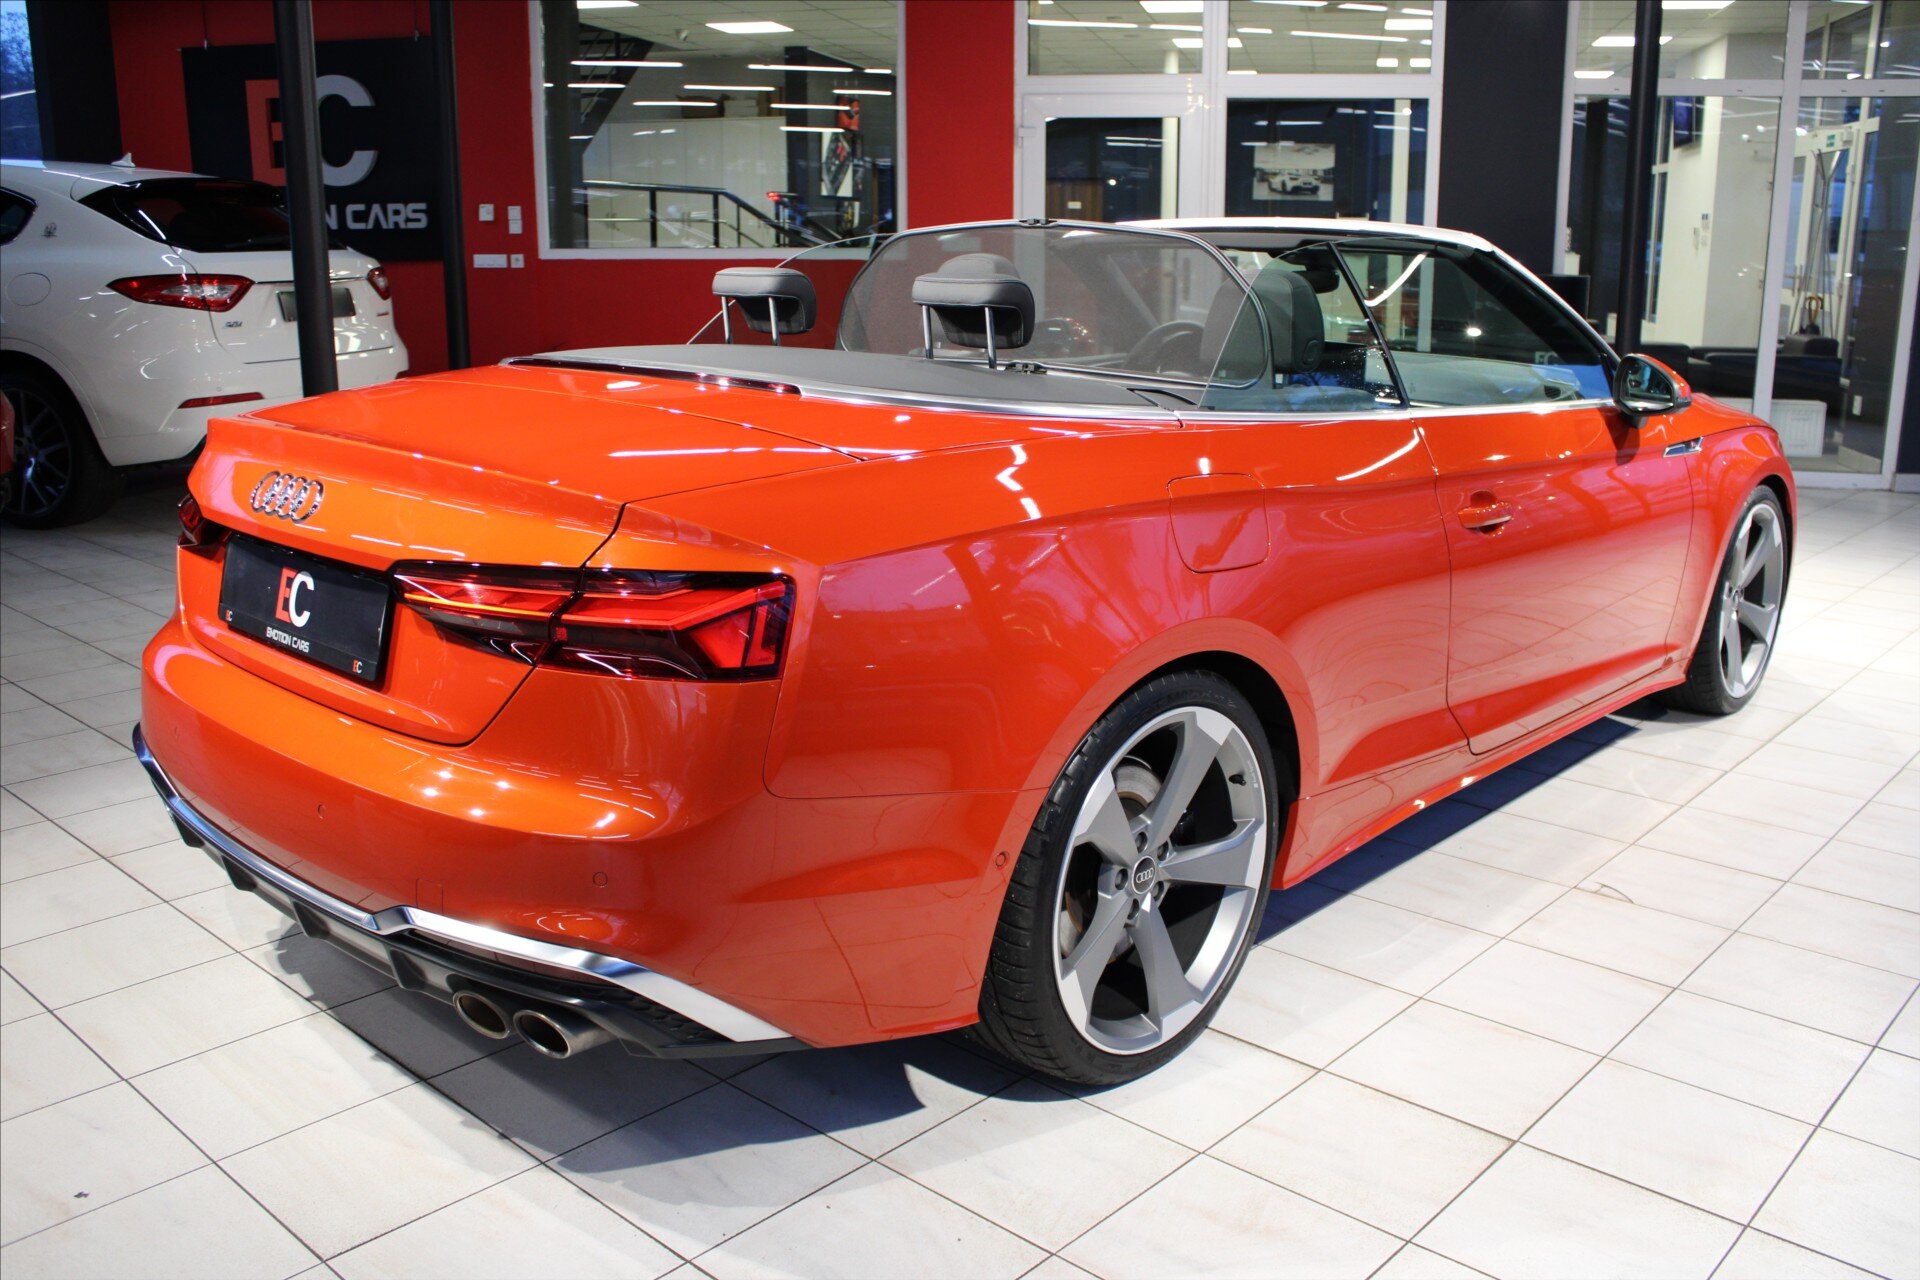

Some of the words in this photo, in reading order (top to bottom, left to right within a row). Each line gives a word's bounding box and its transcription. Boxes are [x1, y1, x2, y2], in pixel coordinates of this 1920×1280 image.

[346, 203, 428, 230] CARS
[275, 567, 315, 627] EC
[266, 626, 292, 646] EMOTION
[291, 636, 310, 653] CARS
[352, 659, 363, 673] EC
